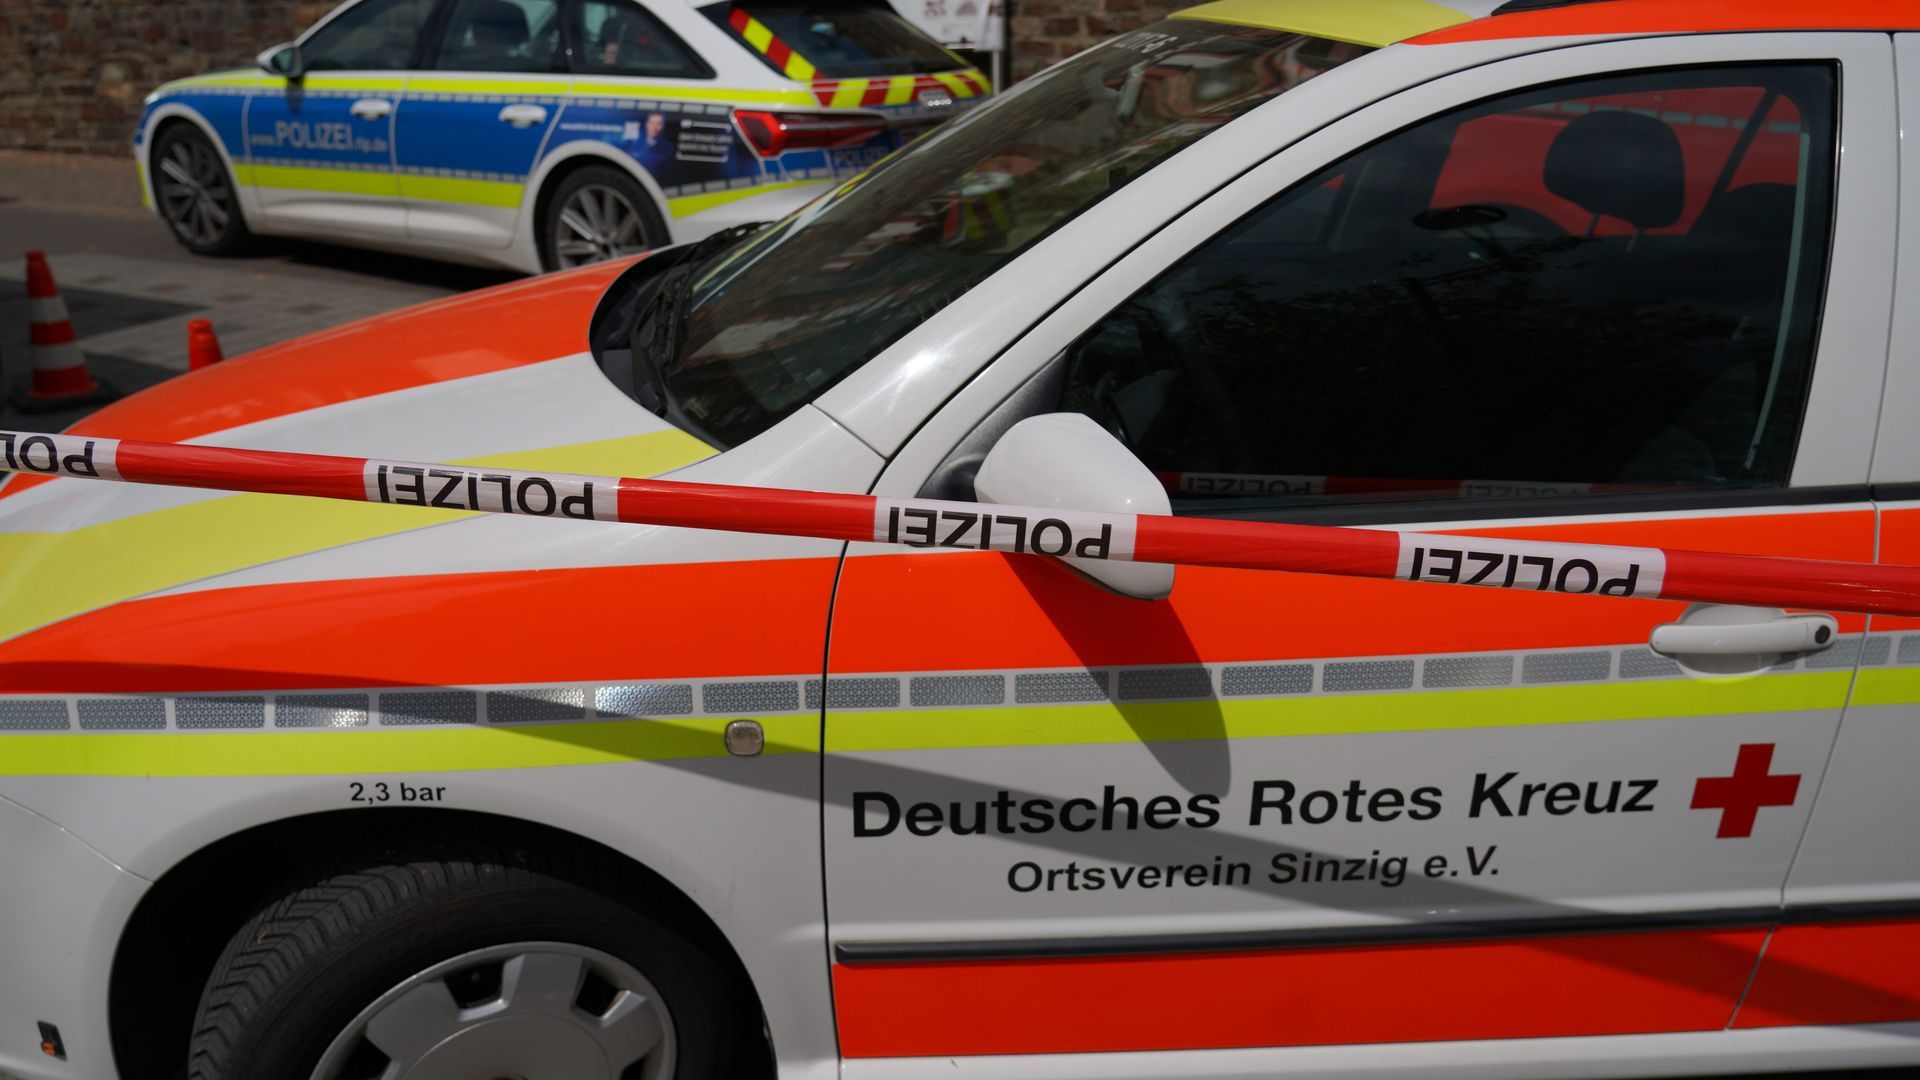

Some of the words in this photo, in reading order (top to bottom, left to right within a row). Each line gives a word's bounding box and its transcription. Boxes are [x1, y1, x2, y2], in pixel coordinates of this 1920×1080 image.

[378, 465, 595, 520] POLIZEI
[888, 506, 1112, 560] POLIZEI
[1408, 547, 1640, 597] POLIZEI
[349, 782, 390, 805] 2,3
[400, 782, 446, 801] bar
[853, 785, 1221, 838] Deutsches
[1249, 780, 1442, 826] Rotes
[1468, 772, 1659, 818] Kreuz
[1007, 855, 1251, 892] Ortsverein
[1268, 850, 1407, 887] Sinzig
[1423, 845, 1500, 878] e.V.
